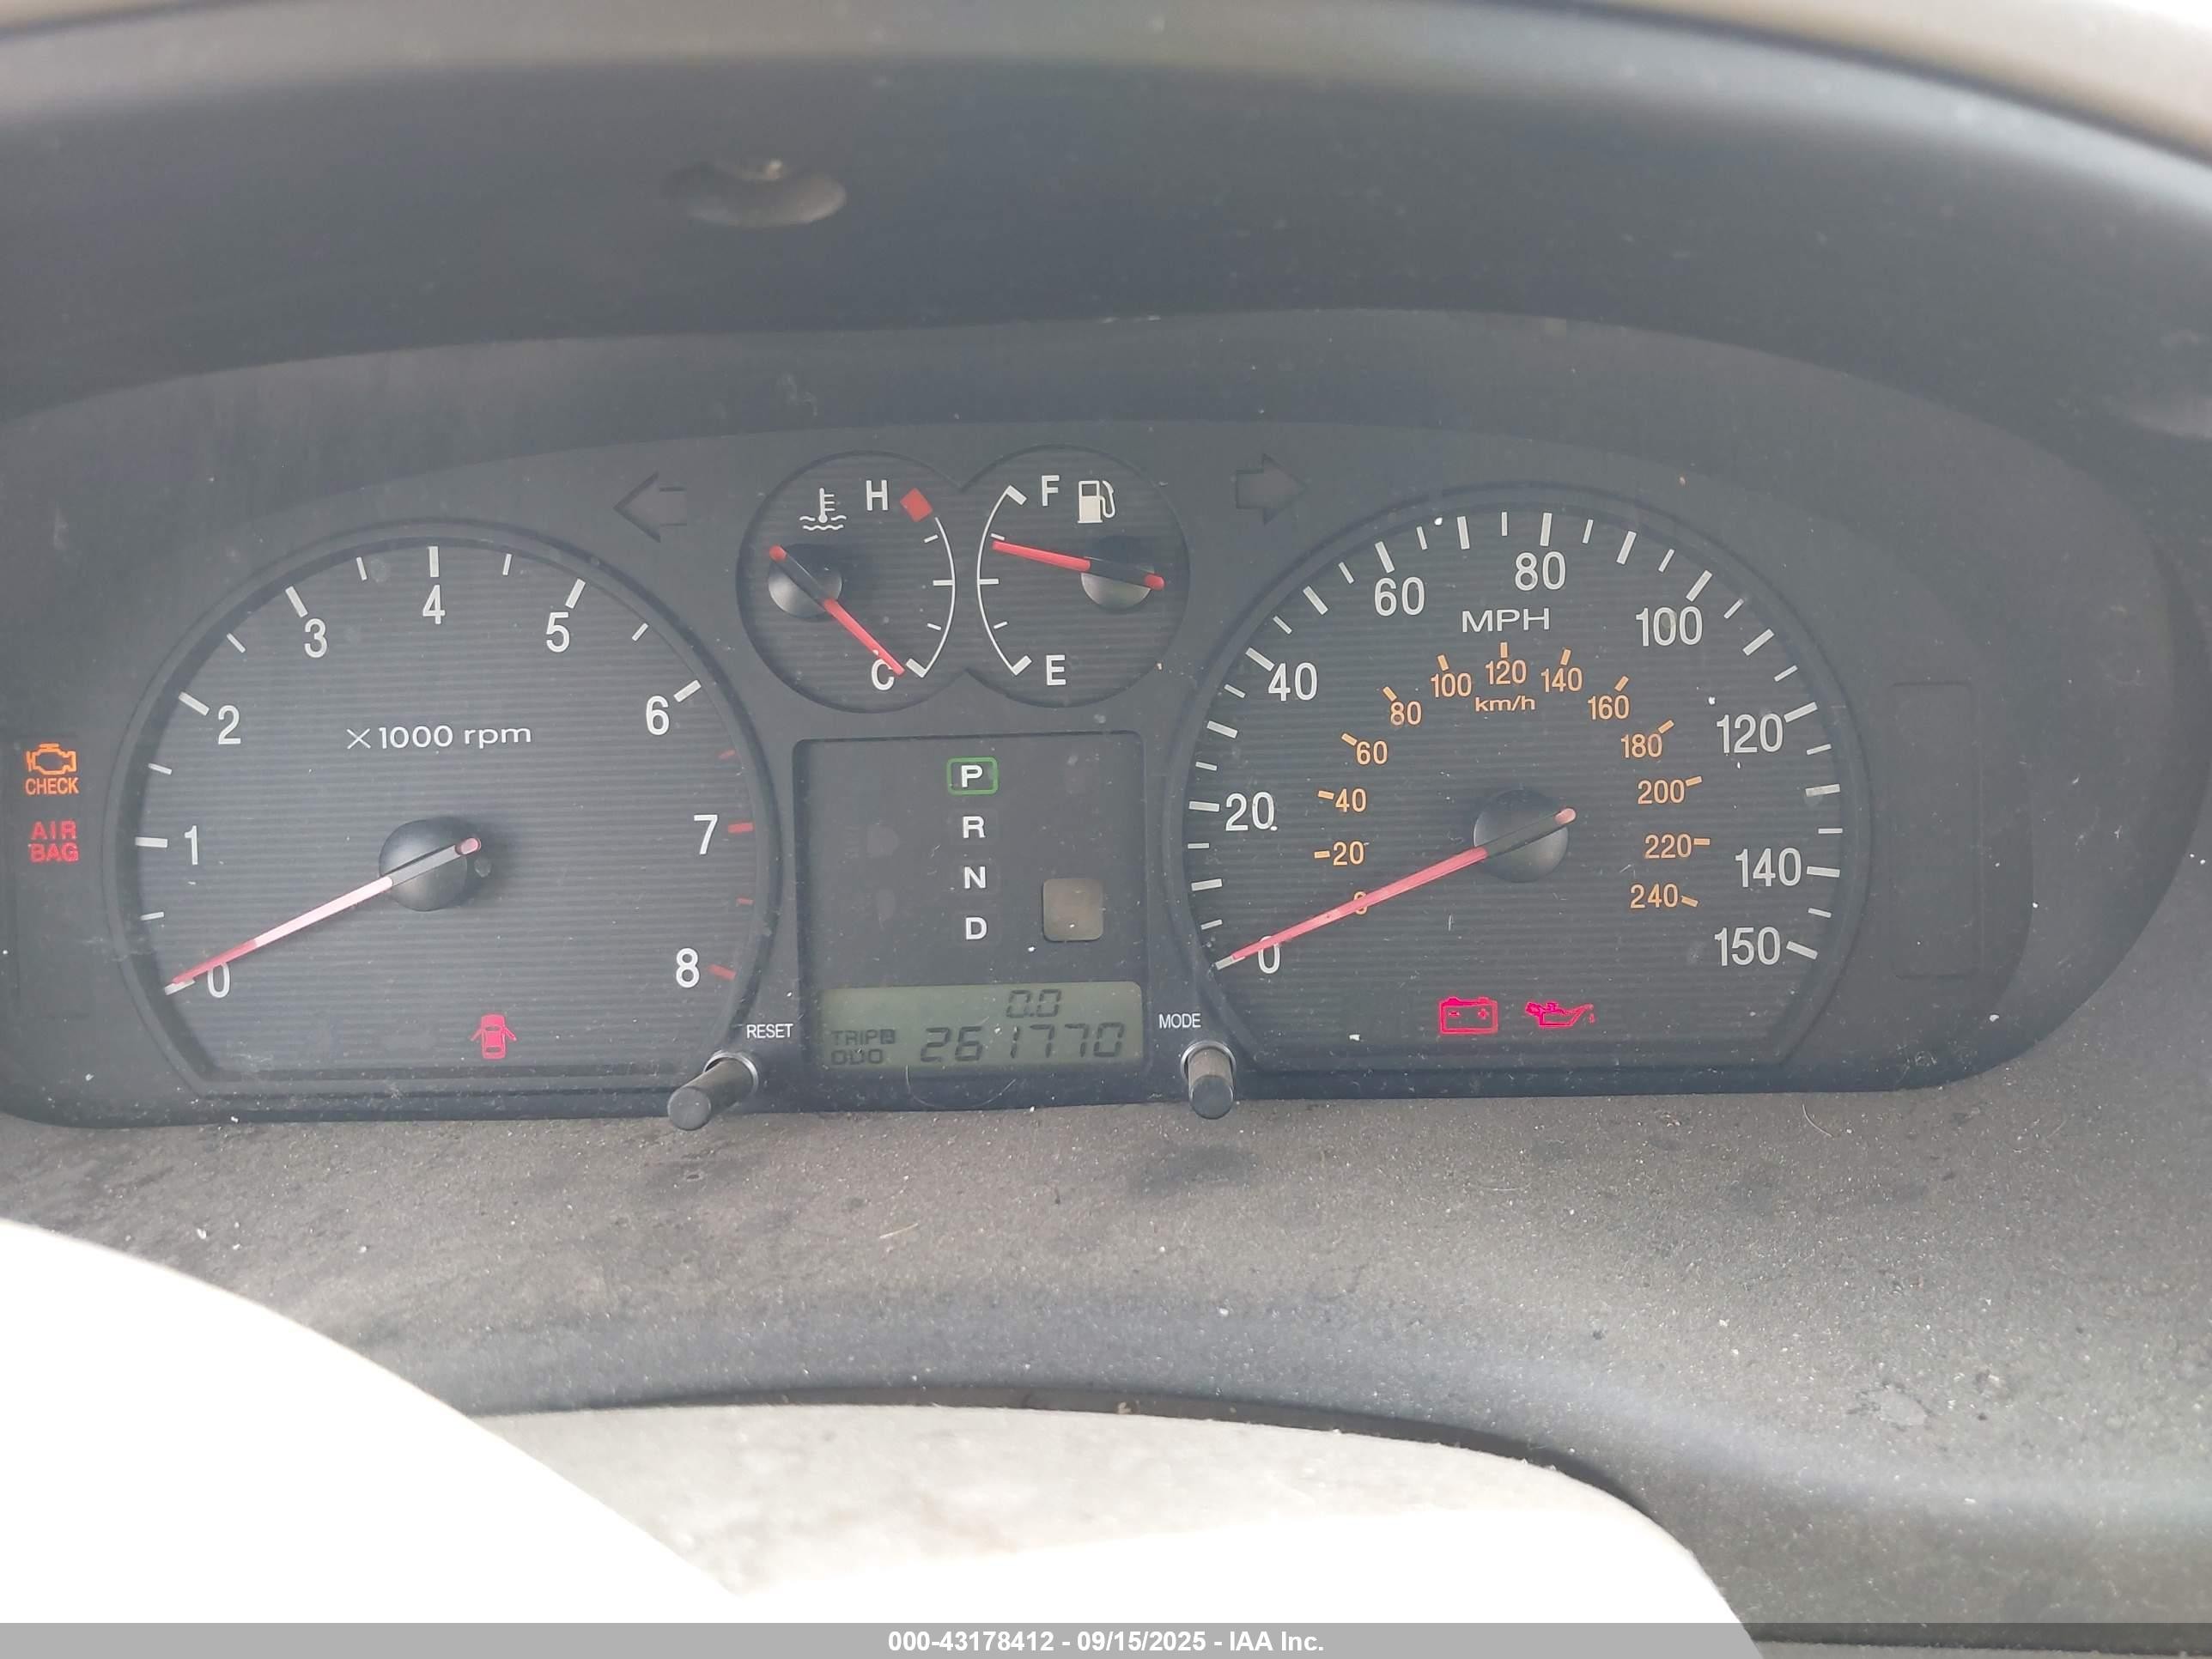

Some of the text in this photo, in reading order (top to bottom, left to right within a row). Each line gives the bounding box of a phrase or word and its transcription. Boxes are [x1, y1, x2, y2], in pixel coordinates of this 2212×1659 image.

[866, 481, 888, 511] H
[1042, 476, 1059, 505] F
[1515, 552, 1565, 590] 80
[422, 585, 446, 624] 4
[1374, 577, 1425, 616] 60
[545, 612, 570, 653] 5
[1462, 608, 1551, 633] MPH
[1636, 606, 1702, 646] 100
[304, 619, 328, 658] 3
[871, 659, 895, 690] C
[1047, 655, 1066, 686] E
[1268, 662, 1318, 701] 40
[1485, 660, 1526, 685] 120
[1542, 668, 1583, 692] 140
[1431, 673, 1471, 698] 100
[646, 696, 670, 735] 6
[1390, 702, 1422, 726] 80
[1475, 695, 1535, 713] km/h
[1589, 696, 1629, 720] 160
[217, 706, 241, 745] 2
[464, 724, 532, 745] rpm
[1717, 714, 1783, 754] 120
[1356, 740, 1388, 765] 60
[1621, 733, 1662, 757] 180
[25, 777, 79, 795] CHECK
[961, 766, 982, 787] P
[1335, 788, 1366, 812] 40
[1638, 781, 1684, 805] 200
[1226, 792, 1273, 831] 20
[31, 820, 76, 840] AIR
[694, 815, 718, 854] 7
[964, 817, 986, 838] R
[30, 842, 78, 862] BAG
[184, 826, 198, 865] 1
[1333, 842, 1364, 866] 20
[1645, 834, 1692, 858] 220
[965, 867, 986, 889] N
[1735, 848, 1802, 887] 140
[1630, 884, 1678, 908] 240
[965, 917, 987, 939] D
[1258, 936, 1280, 974] 0
[1715, 927, 1780, 965] 150
[207, 960, 231, 999] 0
[675, 948, 699, 987] 8
[746, 1024, 793, 1039] RESET
[1159, 1013, 1201, 1029] MODE
[920, 1022, 1124, 1063] 261770
